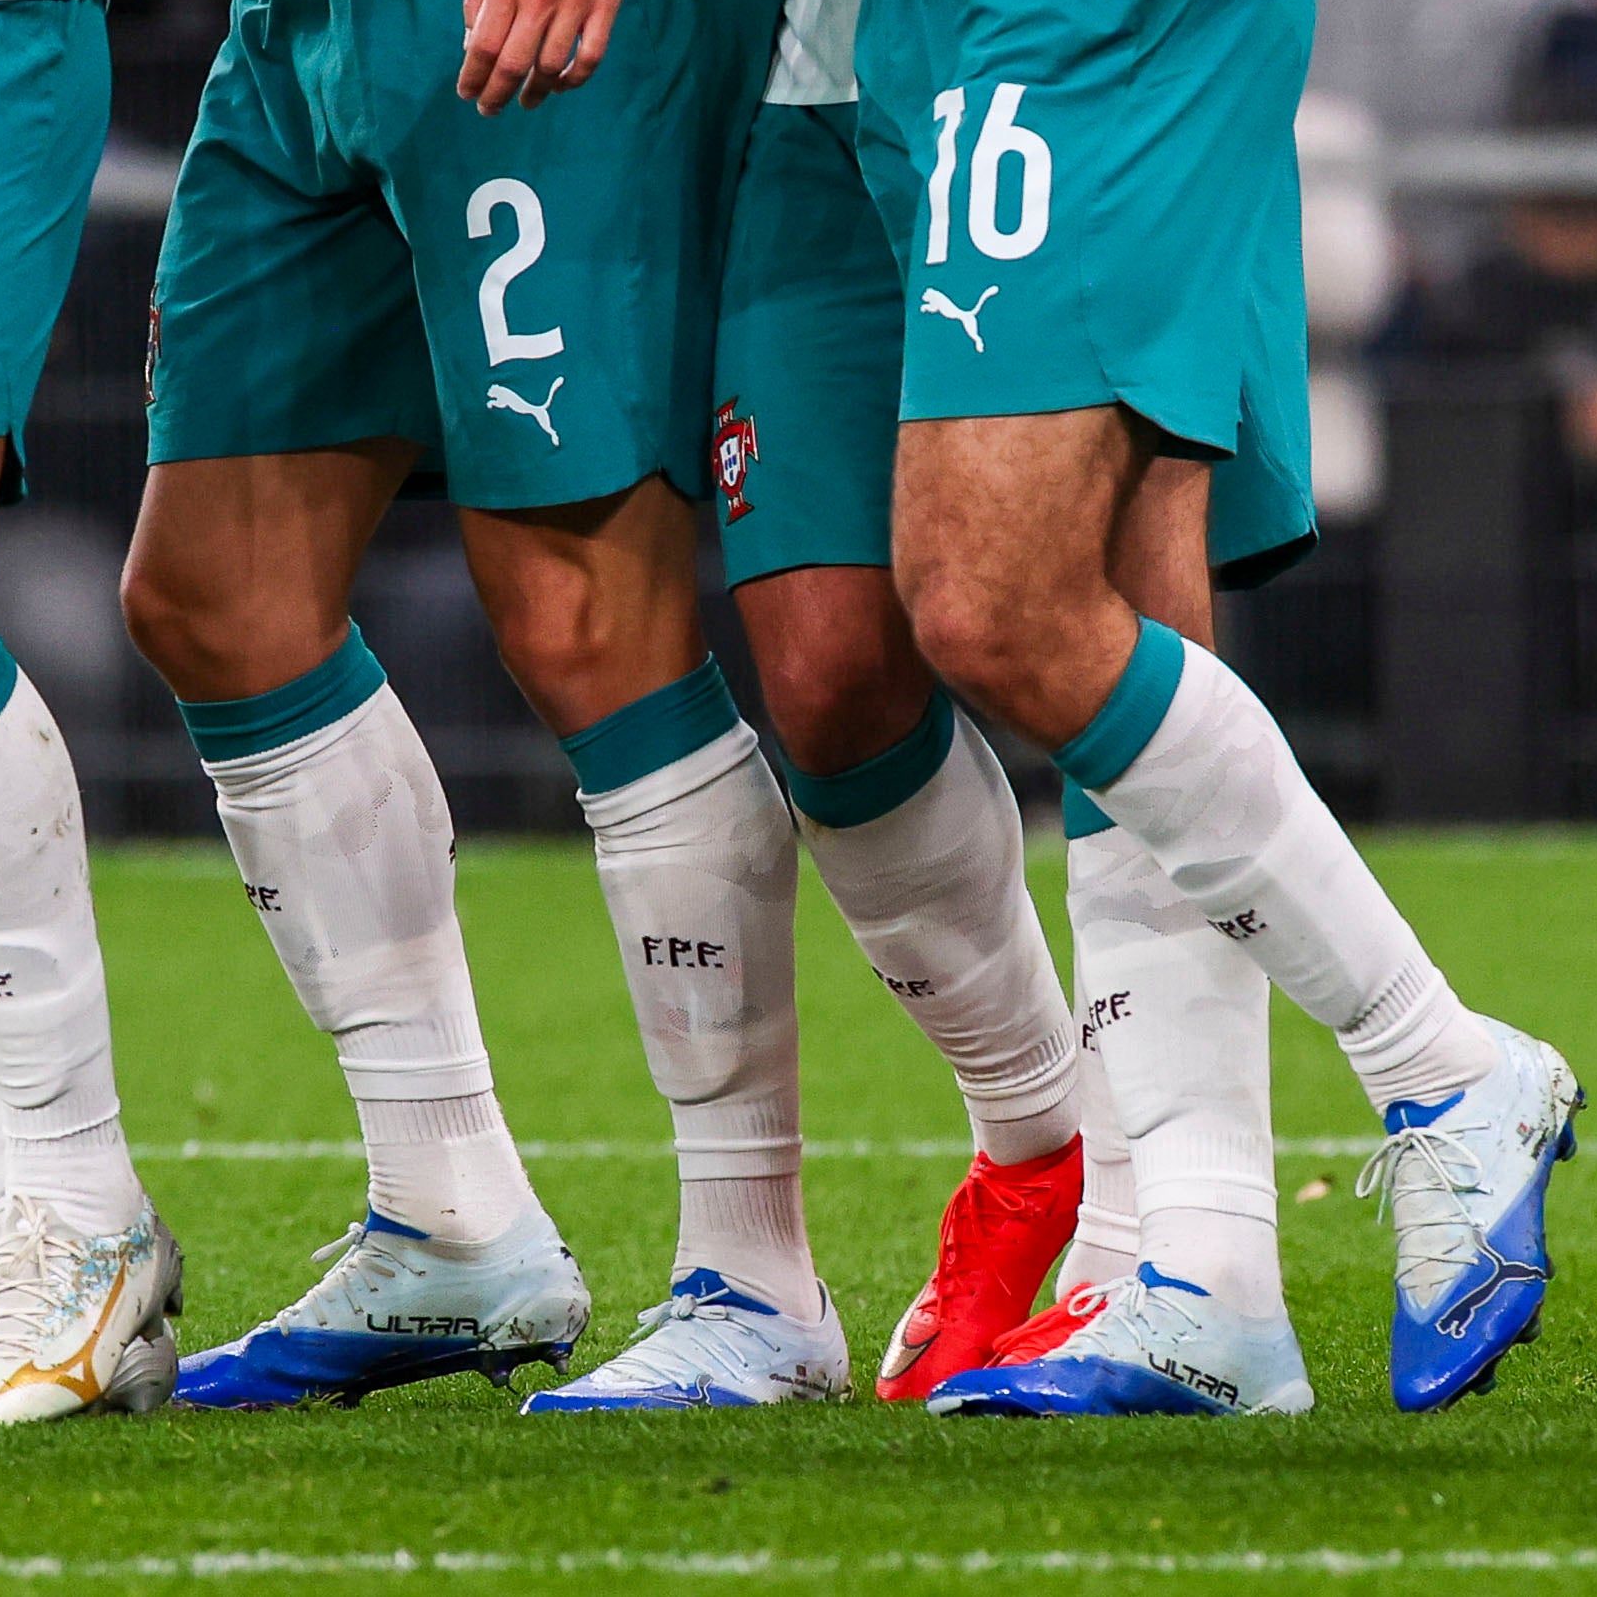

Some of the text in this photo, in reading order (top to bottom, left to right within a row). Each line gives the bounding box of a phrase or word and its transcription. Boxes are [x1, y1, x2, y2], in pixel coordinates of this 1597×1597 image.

[925, 82, 1053, 266] 16
[466, 177, 565, 368] 2
[642, 935, 727, 968] F.P.F.
[366, 1312, 481, 1337] ULTRA
[1147, 1351, 1240, 1407] ULTRA
